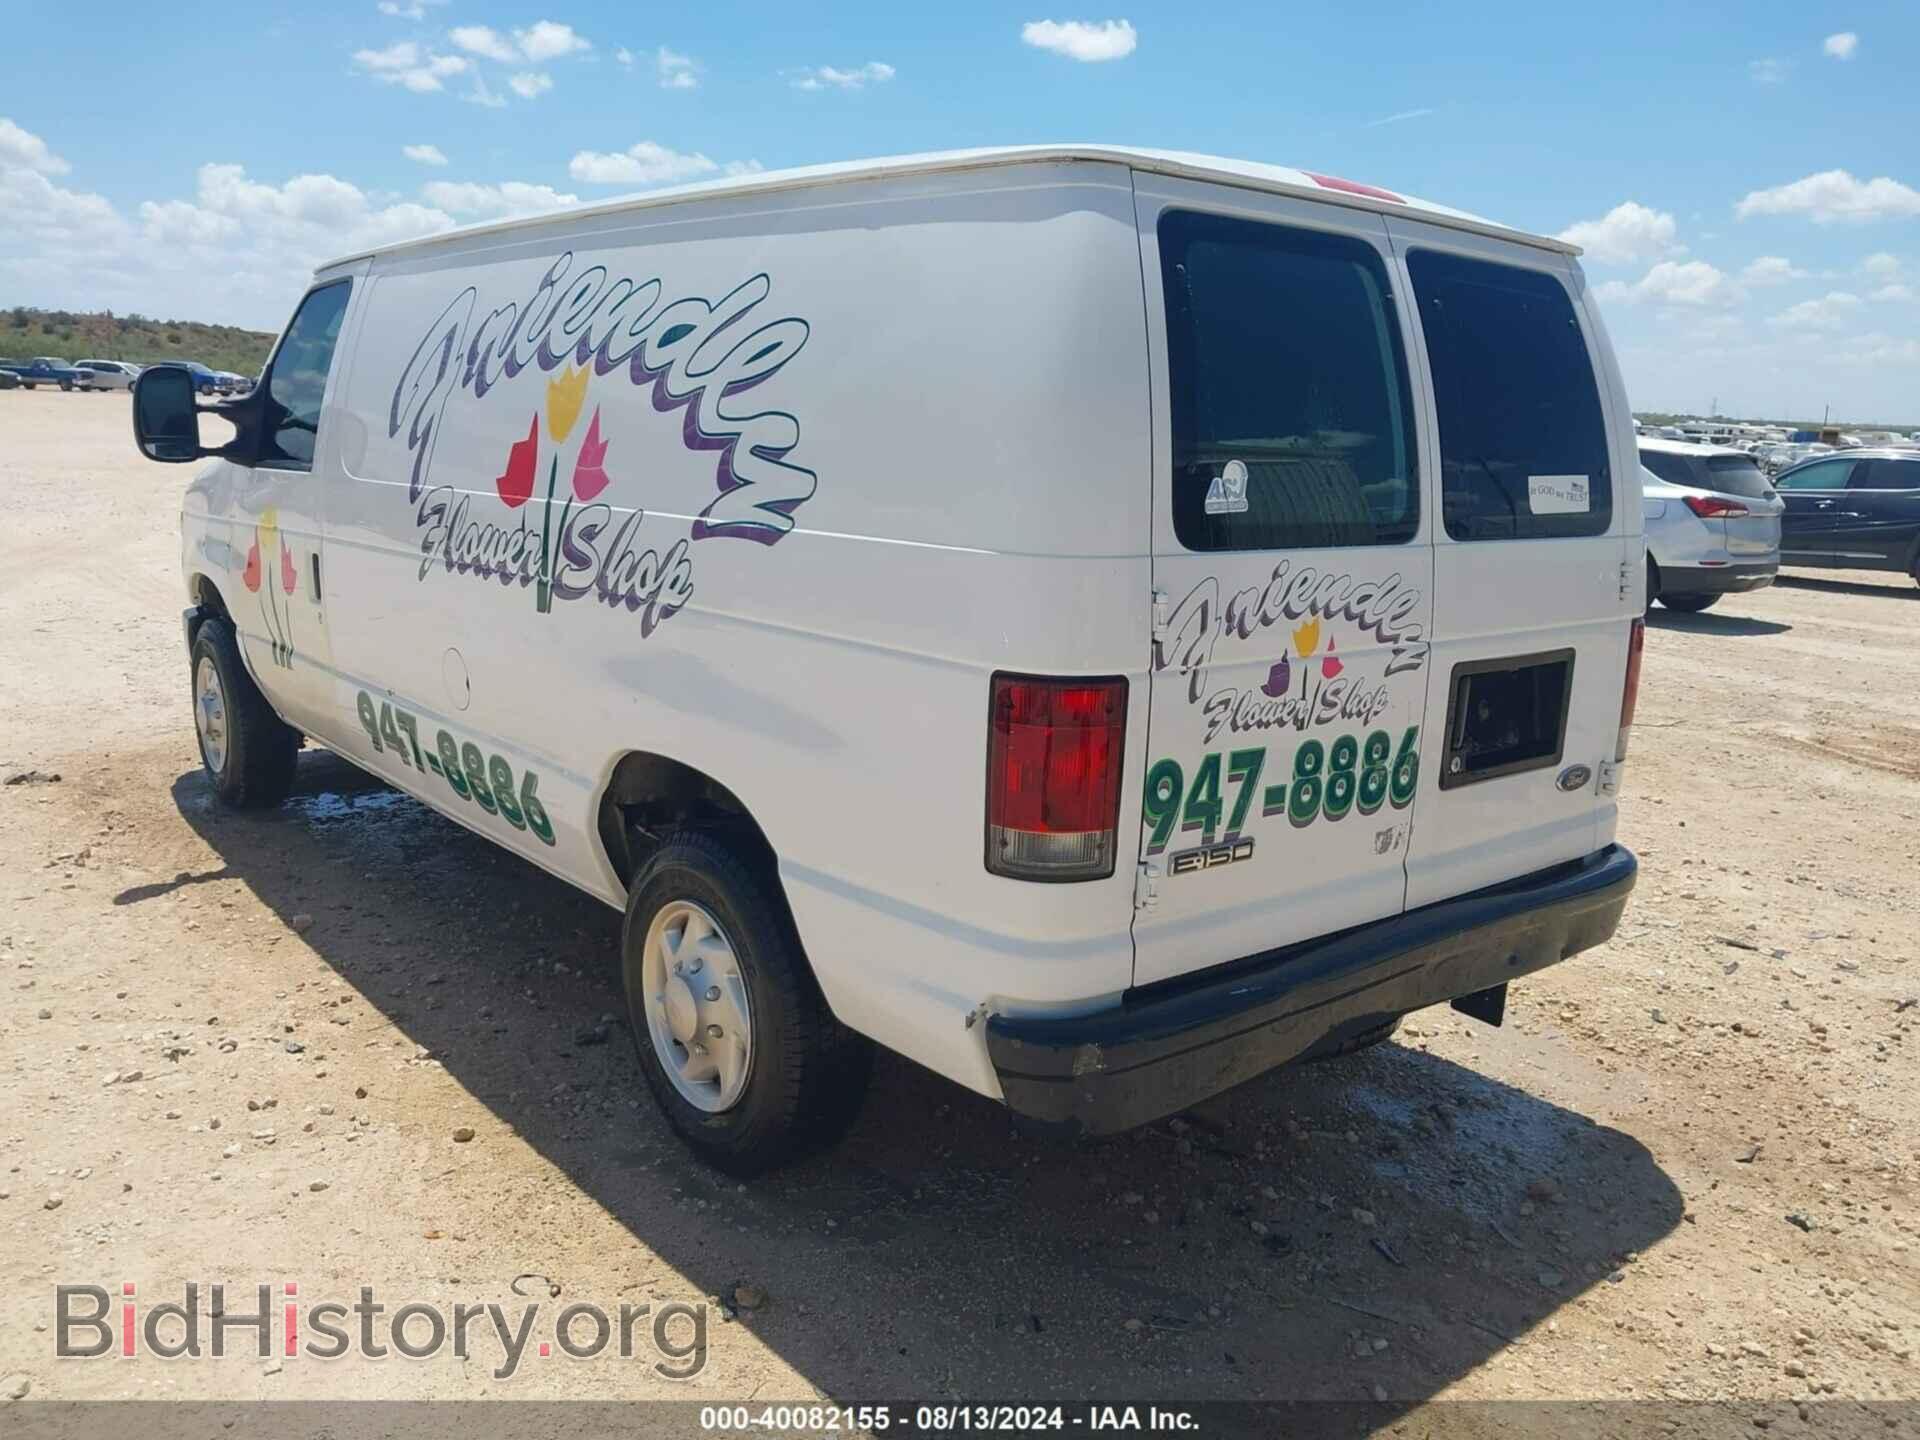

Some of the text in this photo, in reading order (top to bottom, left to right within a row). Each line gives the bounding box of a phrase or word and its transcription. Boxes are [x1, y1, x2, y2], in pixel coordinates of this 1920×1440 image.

[417, 485, 694, 639] Flower Shop
[357, 689, 556, 847] 947-8886
[1203, 677, 1387, 744] Flower Shop
[1144, 725, 1419, 855] 947-8886
